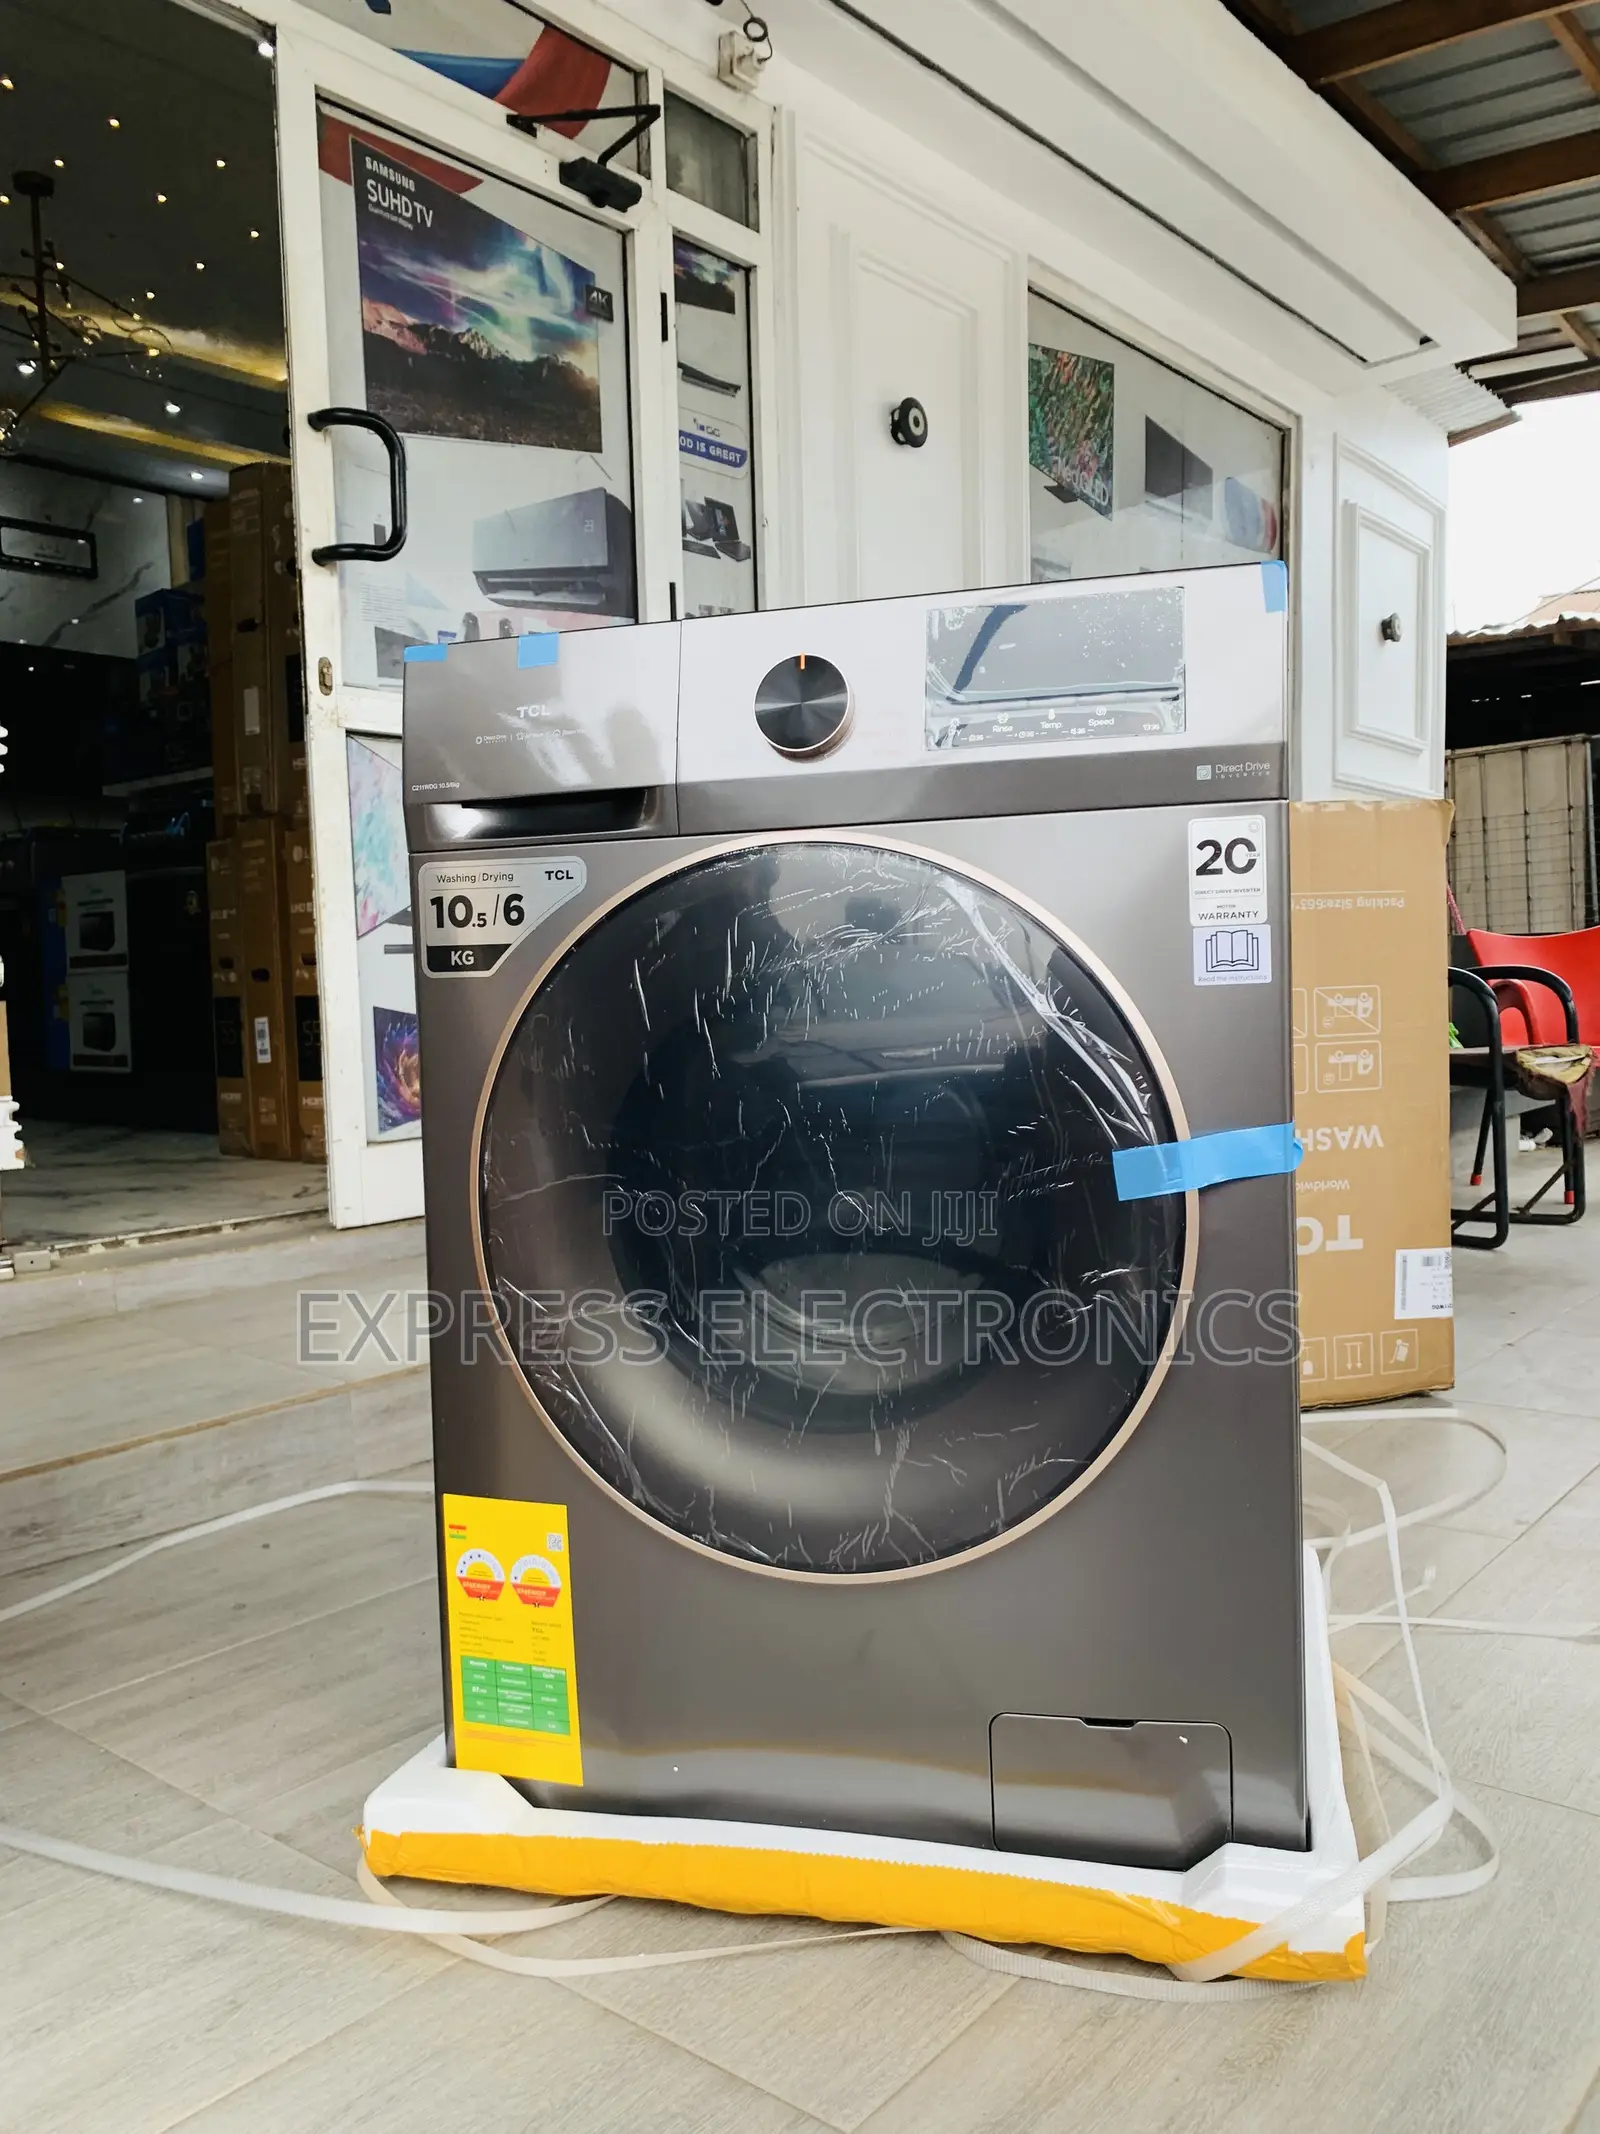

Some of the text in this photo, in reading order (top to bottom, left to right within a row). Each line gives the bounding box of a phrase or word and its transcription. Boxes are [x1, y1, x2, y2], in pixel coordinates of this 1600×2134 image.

[365, 156, 415, 192] SAMSUNG
[696, 440, 706, 453] IS
[709, 445, 741, 464] GREAT
[516, 704, 551, 718] TCL
[992, 724, 1014, 733] Rinse
[1088, 717, 1115, 728] Speed
[1215, 761, 1271, 774] Direct Drive
[545, 870, 574, 881] TCL
[1356, 896, 1405, 909] Packing
[1197, 910, 1259, 921] WARRANTY
[450, 950, 475, 966] KG
